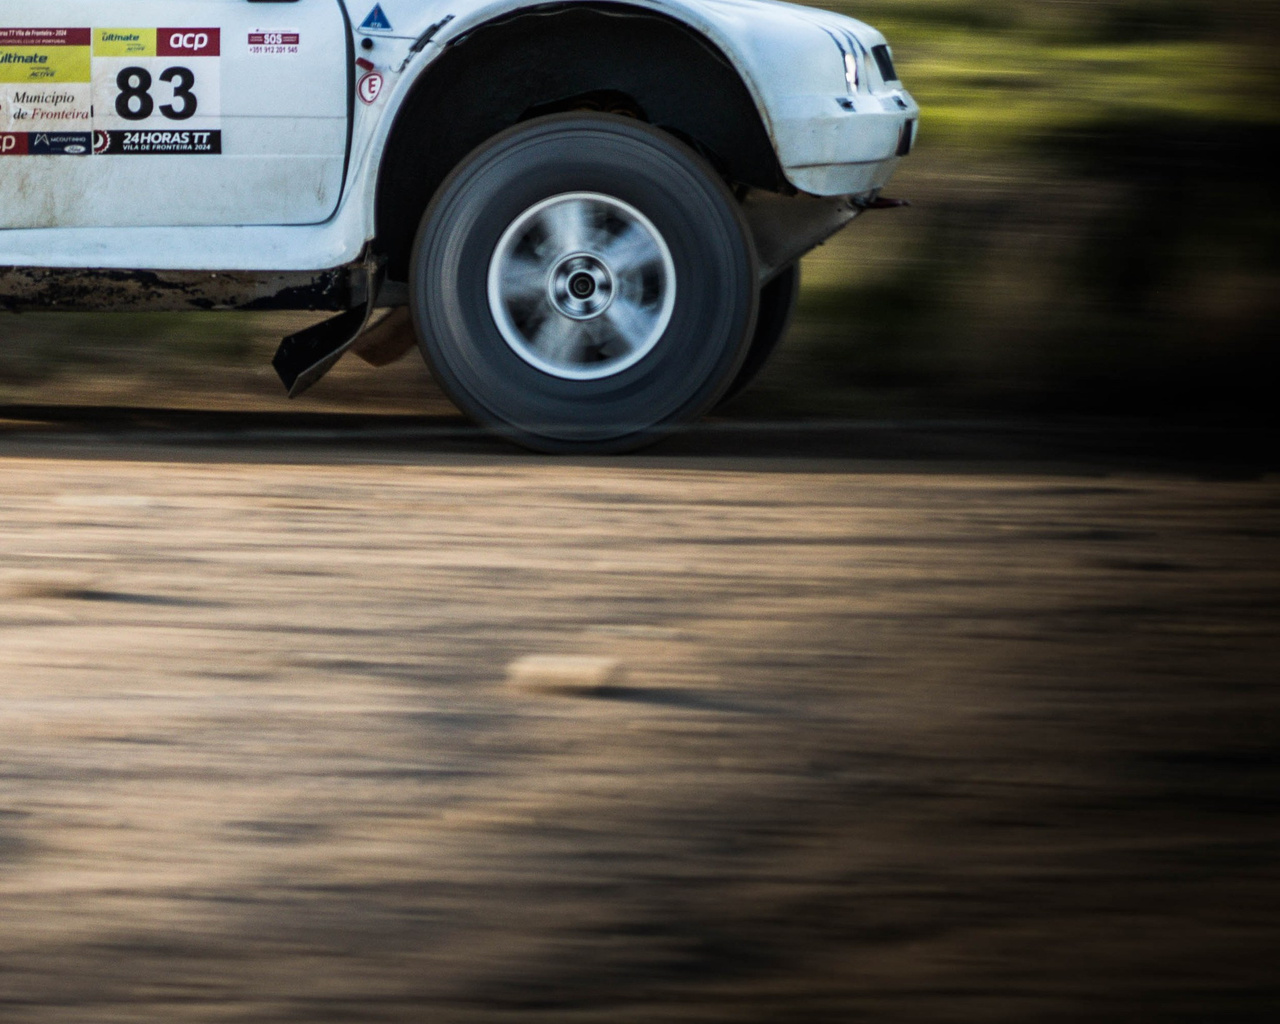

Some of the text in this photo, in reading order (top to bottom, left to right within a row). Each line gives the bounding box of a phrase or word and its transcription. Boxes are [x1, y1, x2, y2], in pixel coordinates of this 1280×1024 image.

[169, 32, 209, 51] acp
[264, 33, 282, 44] SOS
[115, 66, 198, 120] 83
[368, 78, 377, 94] E
[13, 91, 75, 106] Município
[13, 108, 89, 120] de Fronteira
[192, 132, 211, 144] TT
